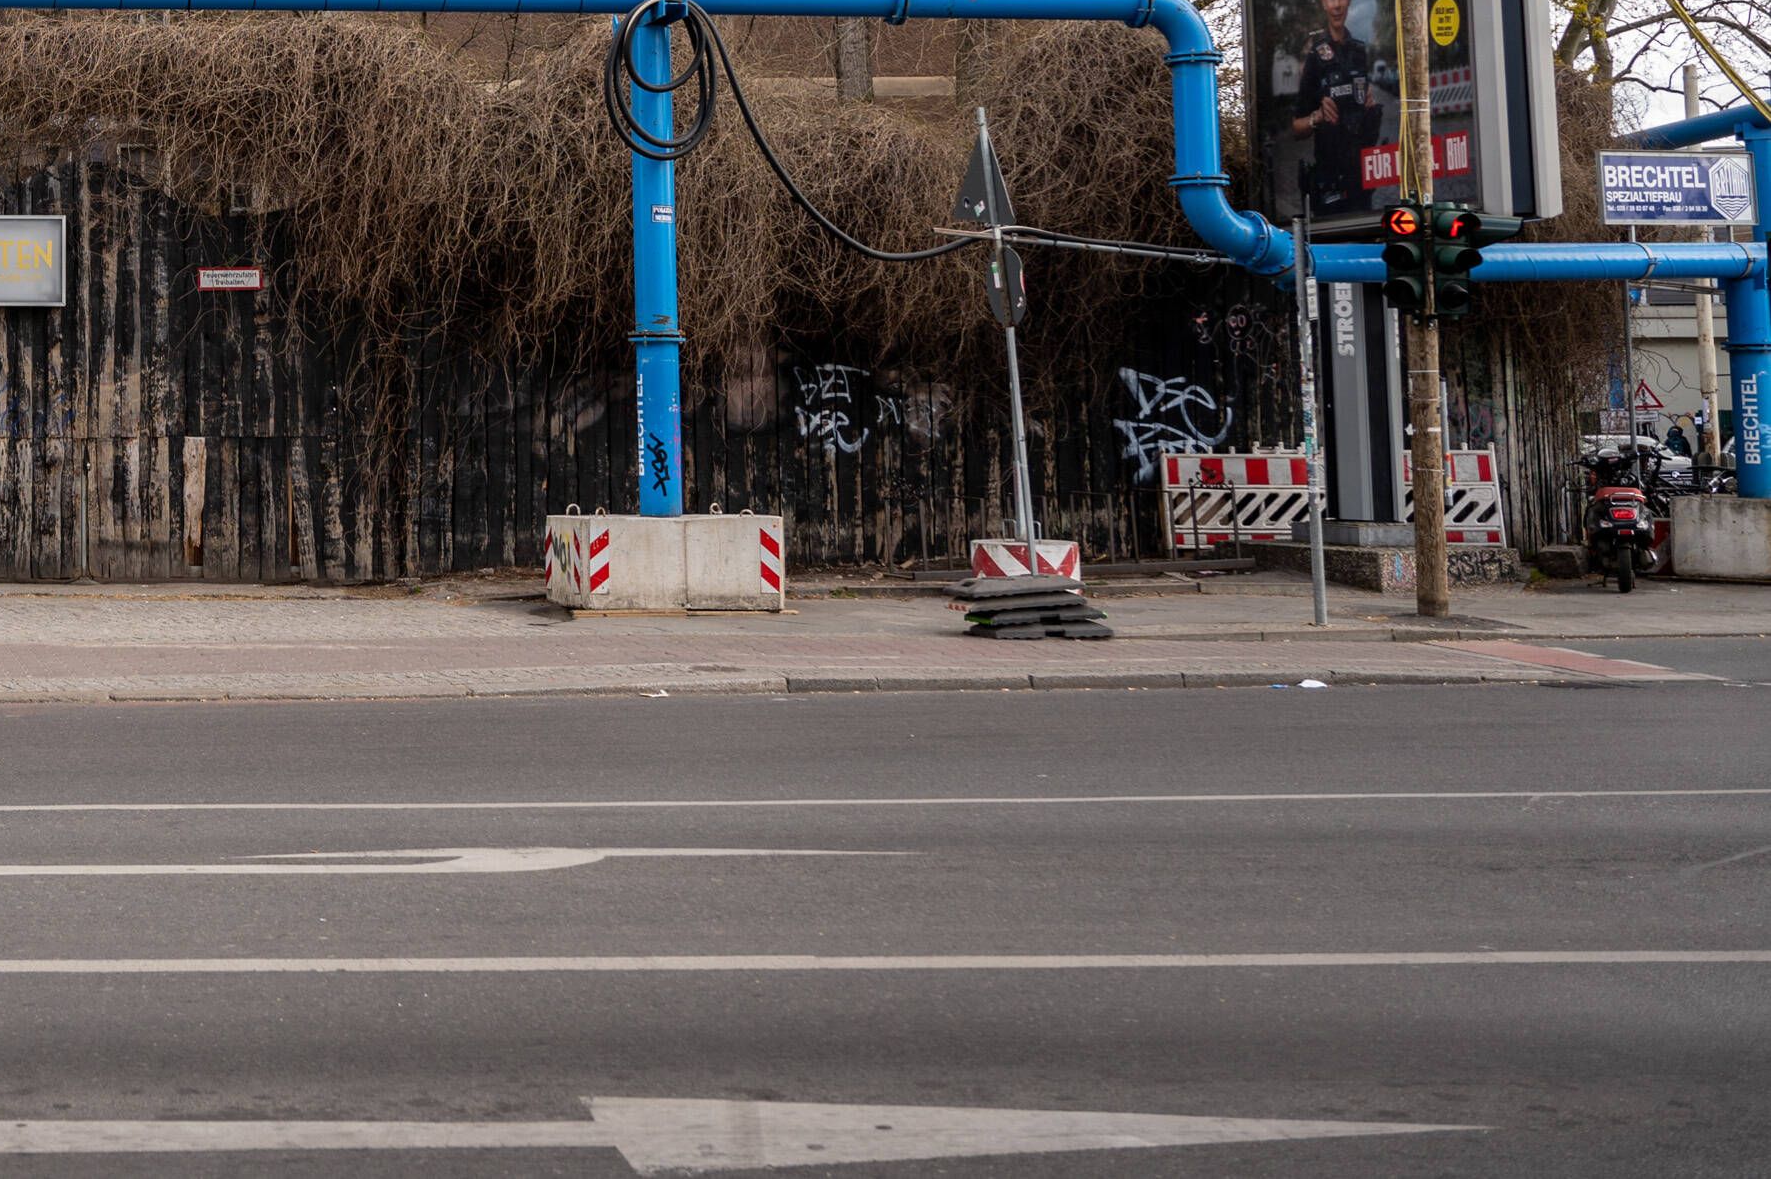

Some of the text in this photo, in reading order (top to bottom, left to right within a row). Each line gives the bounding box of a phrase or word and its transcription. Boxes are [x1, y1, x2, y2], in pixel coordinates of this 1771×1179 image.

[1330, 83, 1353, 98] POLIZEI
[1364, 149, 1392, 181] FÜR
[1446, 135, 1468, 171] Bild
[1604, 165, 1707, 188] BRECHTEL
[1606, 191, 1682, 203] SPEZIALTIEFBAU
[636, 373, 645, 477] BRECHTEL
[1740, 373, 1762, 465] BRECHTEL
